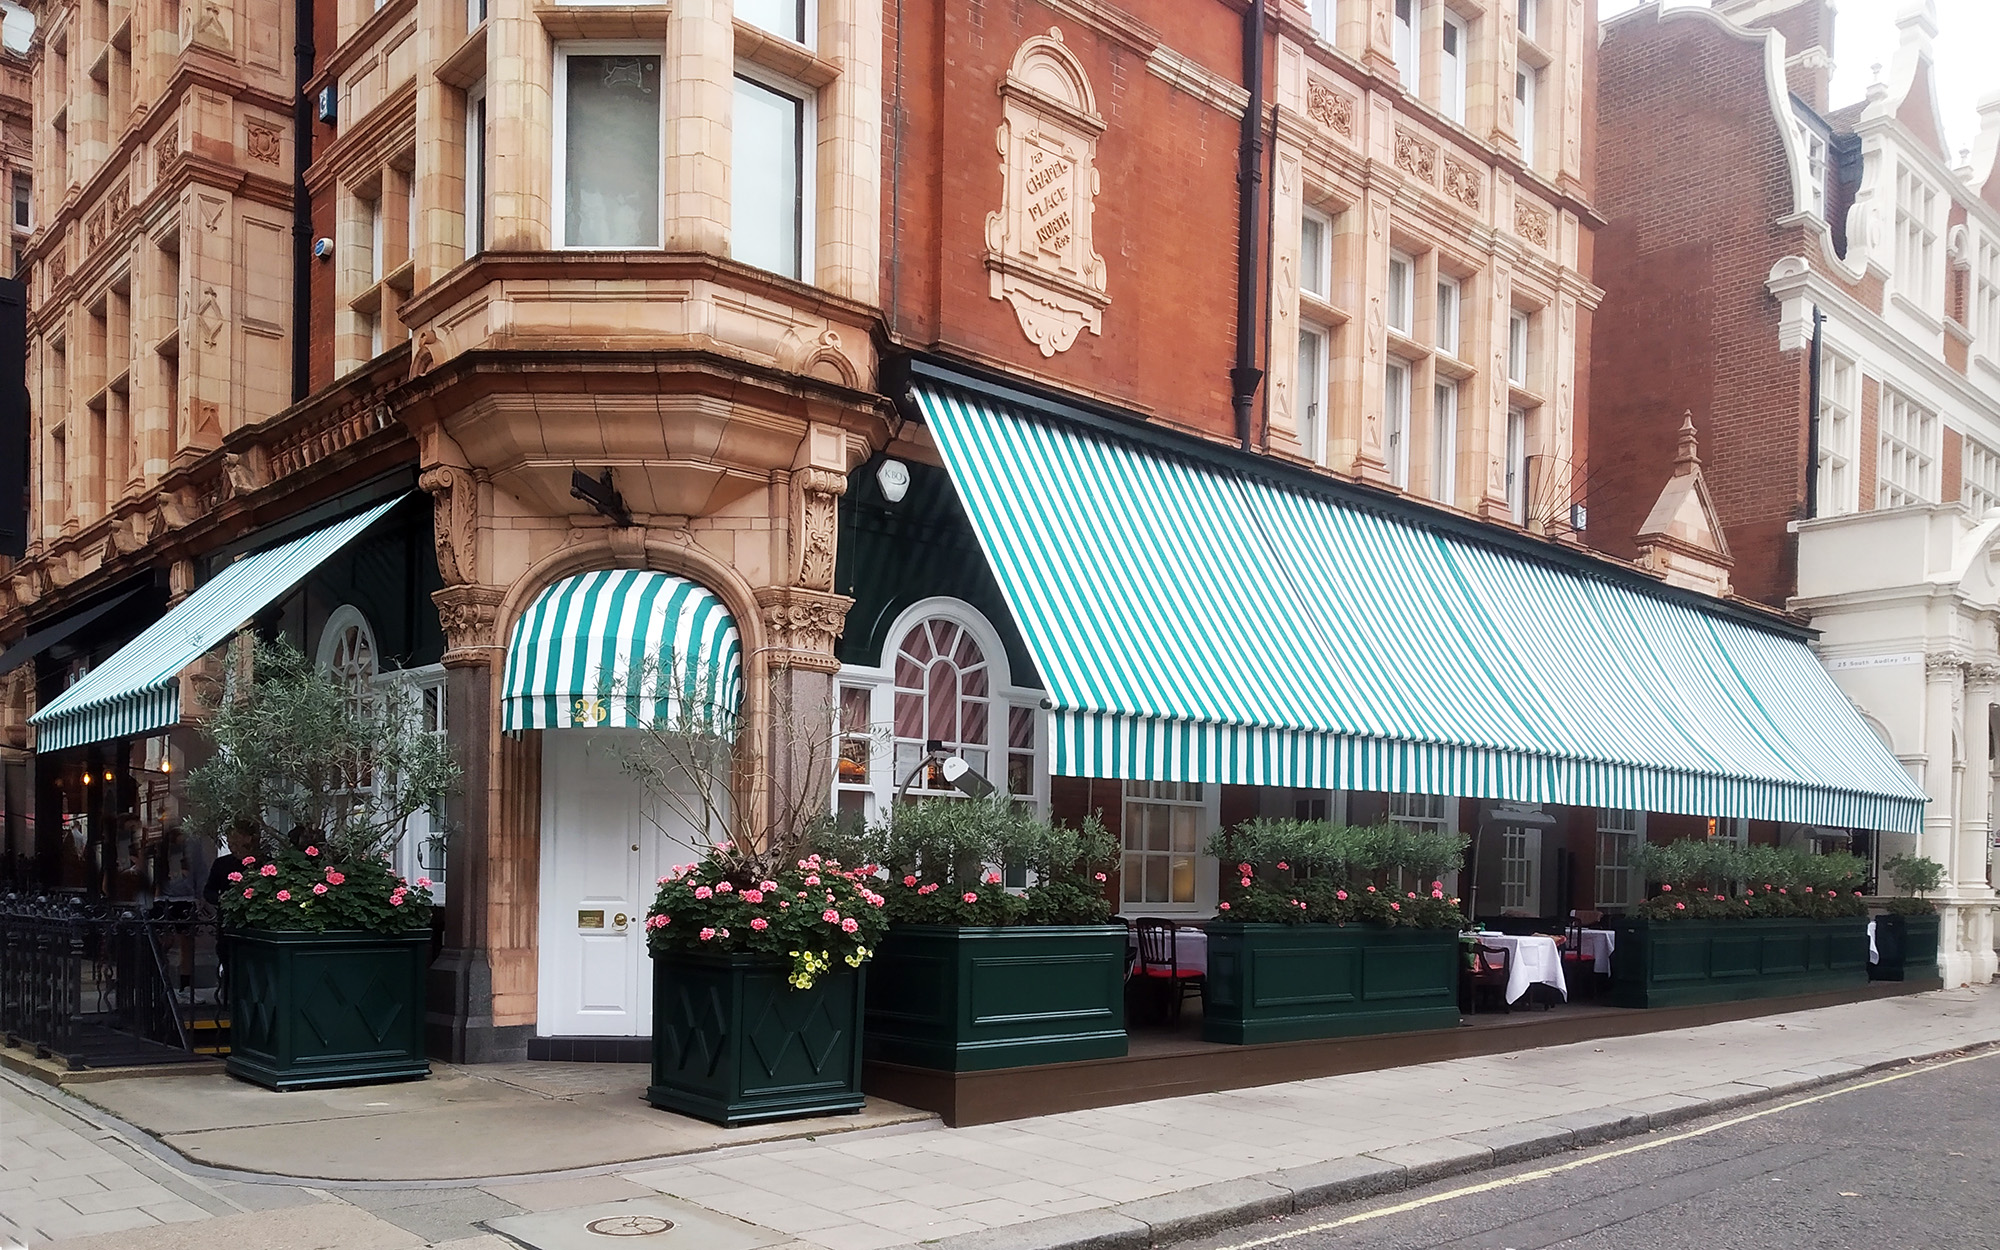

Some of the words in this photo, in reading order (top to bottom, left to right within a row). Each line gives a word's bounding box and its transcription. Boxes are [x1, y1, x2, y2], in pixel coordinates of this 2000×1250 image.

[1025, 161, 1068, 195] CHAPEL
[1027, 186, 1068, 222] PLACE
[1036, 211, 1071, 244] NORTH
[574, 698, 607, 723] 26
